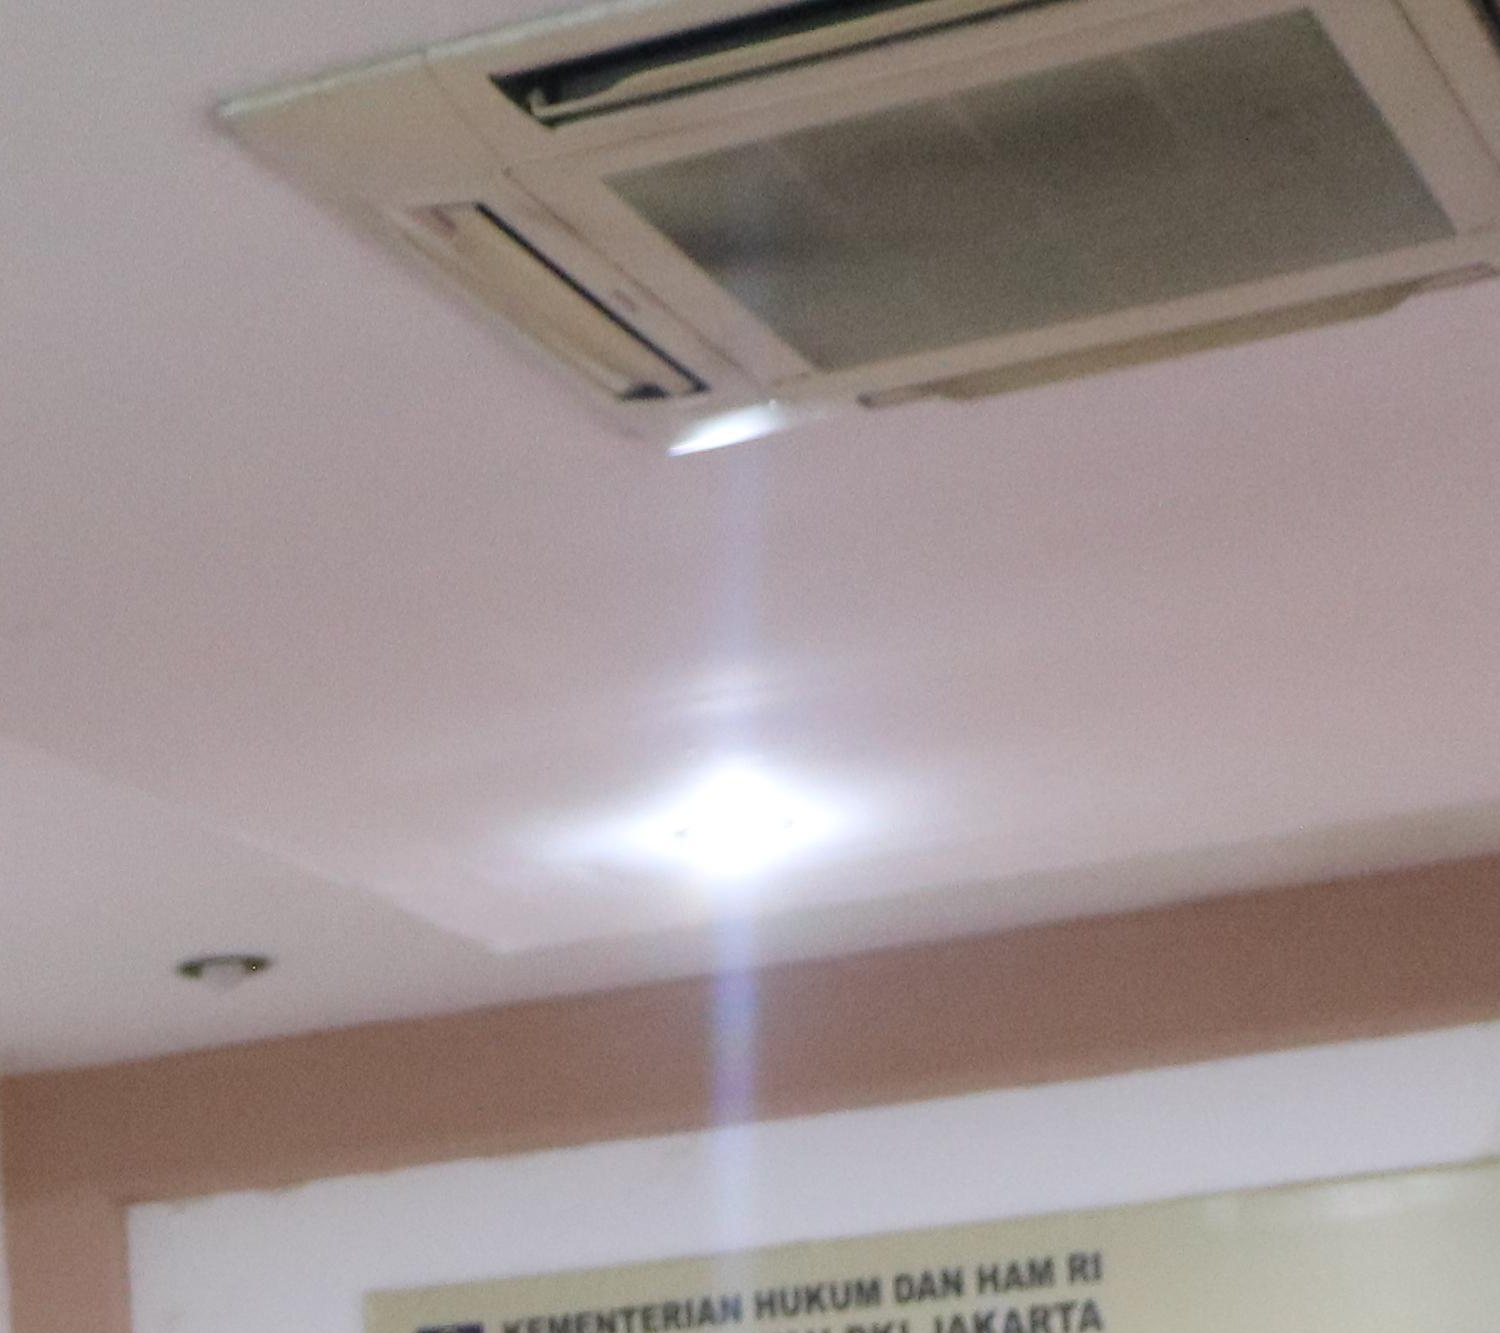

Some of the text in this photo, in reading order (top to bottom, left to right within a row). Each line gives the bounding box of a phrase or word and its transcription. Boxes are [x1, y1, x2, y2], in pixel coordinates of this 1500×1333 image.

[754, 1277, 882, 1318] HUKUM
[894, 1266, 963, 1302] DAN
[977, 1256, 1054, 1294] HAM
[1068, 1251, 1102, 1284] RI
